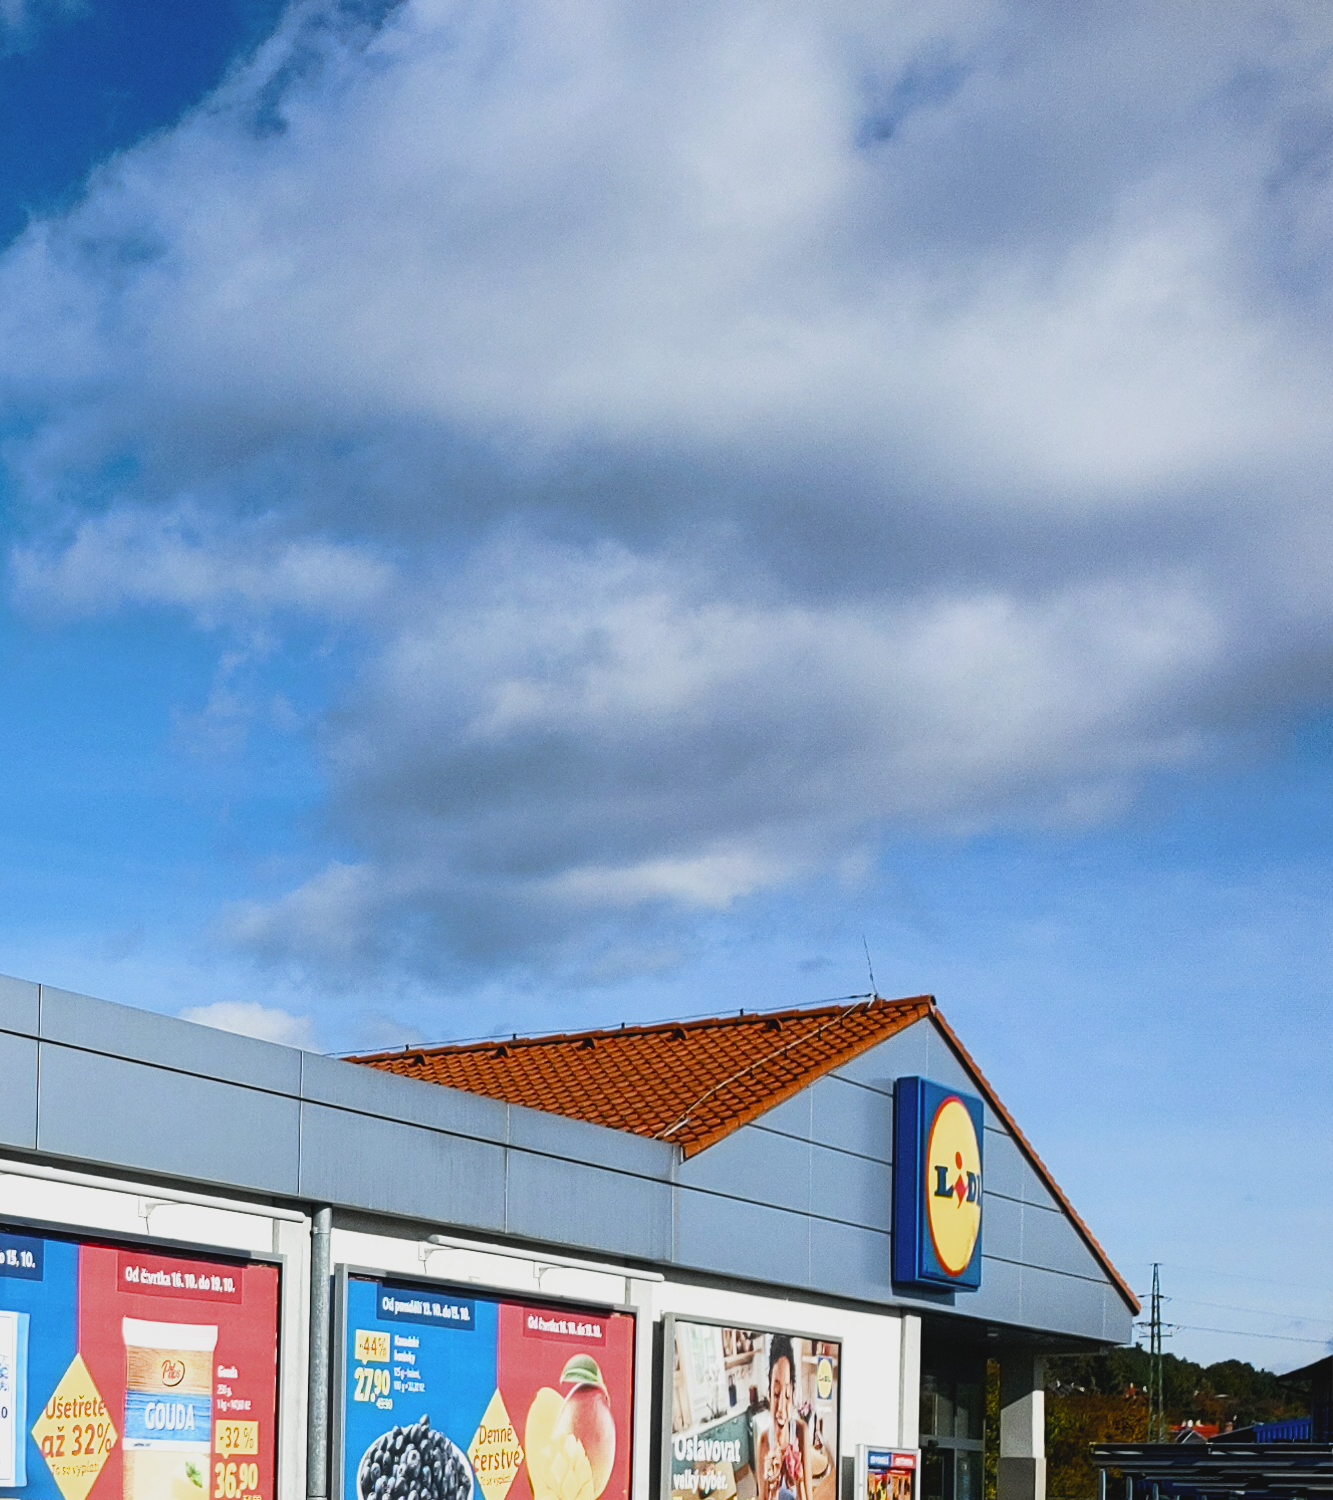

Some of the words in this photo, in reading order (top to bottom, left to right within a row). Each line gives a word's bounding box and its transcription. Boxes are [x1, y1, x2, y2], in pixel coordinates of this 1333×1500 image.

[21, 1251, 36, 1269] 10.
[125, 1265, 140, 1283] Od
[198, 1274, 211, 1291] do
[382, 1296, 395, 1311] Od
[46, 1394, 106, 1420] Ušetřete
[144, 1402, 196, 1431] GOUDA
[42, 1425, 66, 1459] až
[72, 1422, 112, 1457] 32%
[479, 1423, 513, 1445] Denně
[674, 1434, 741, 1465] Oslavovat
